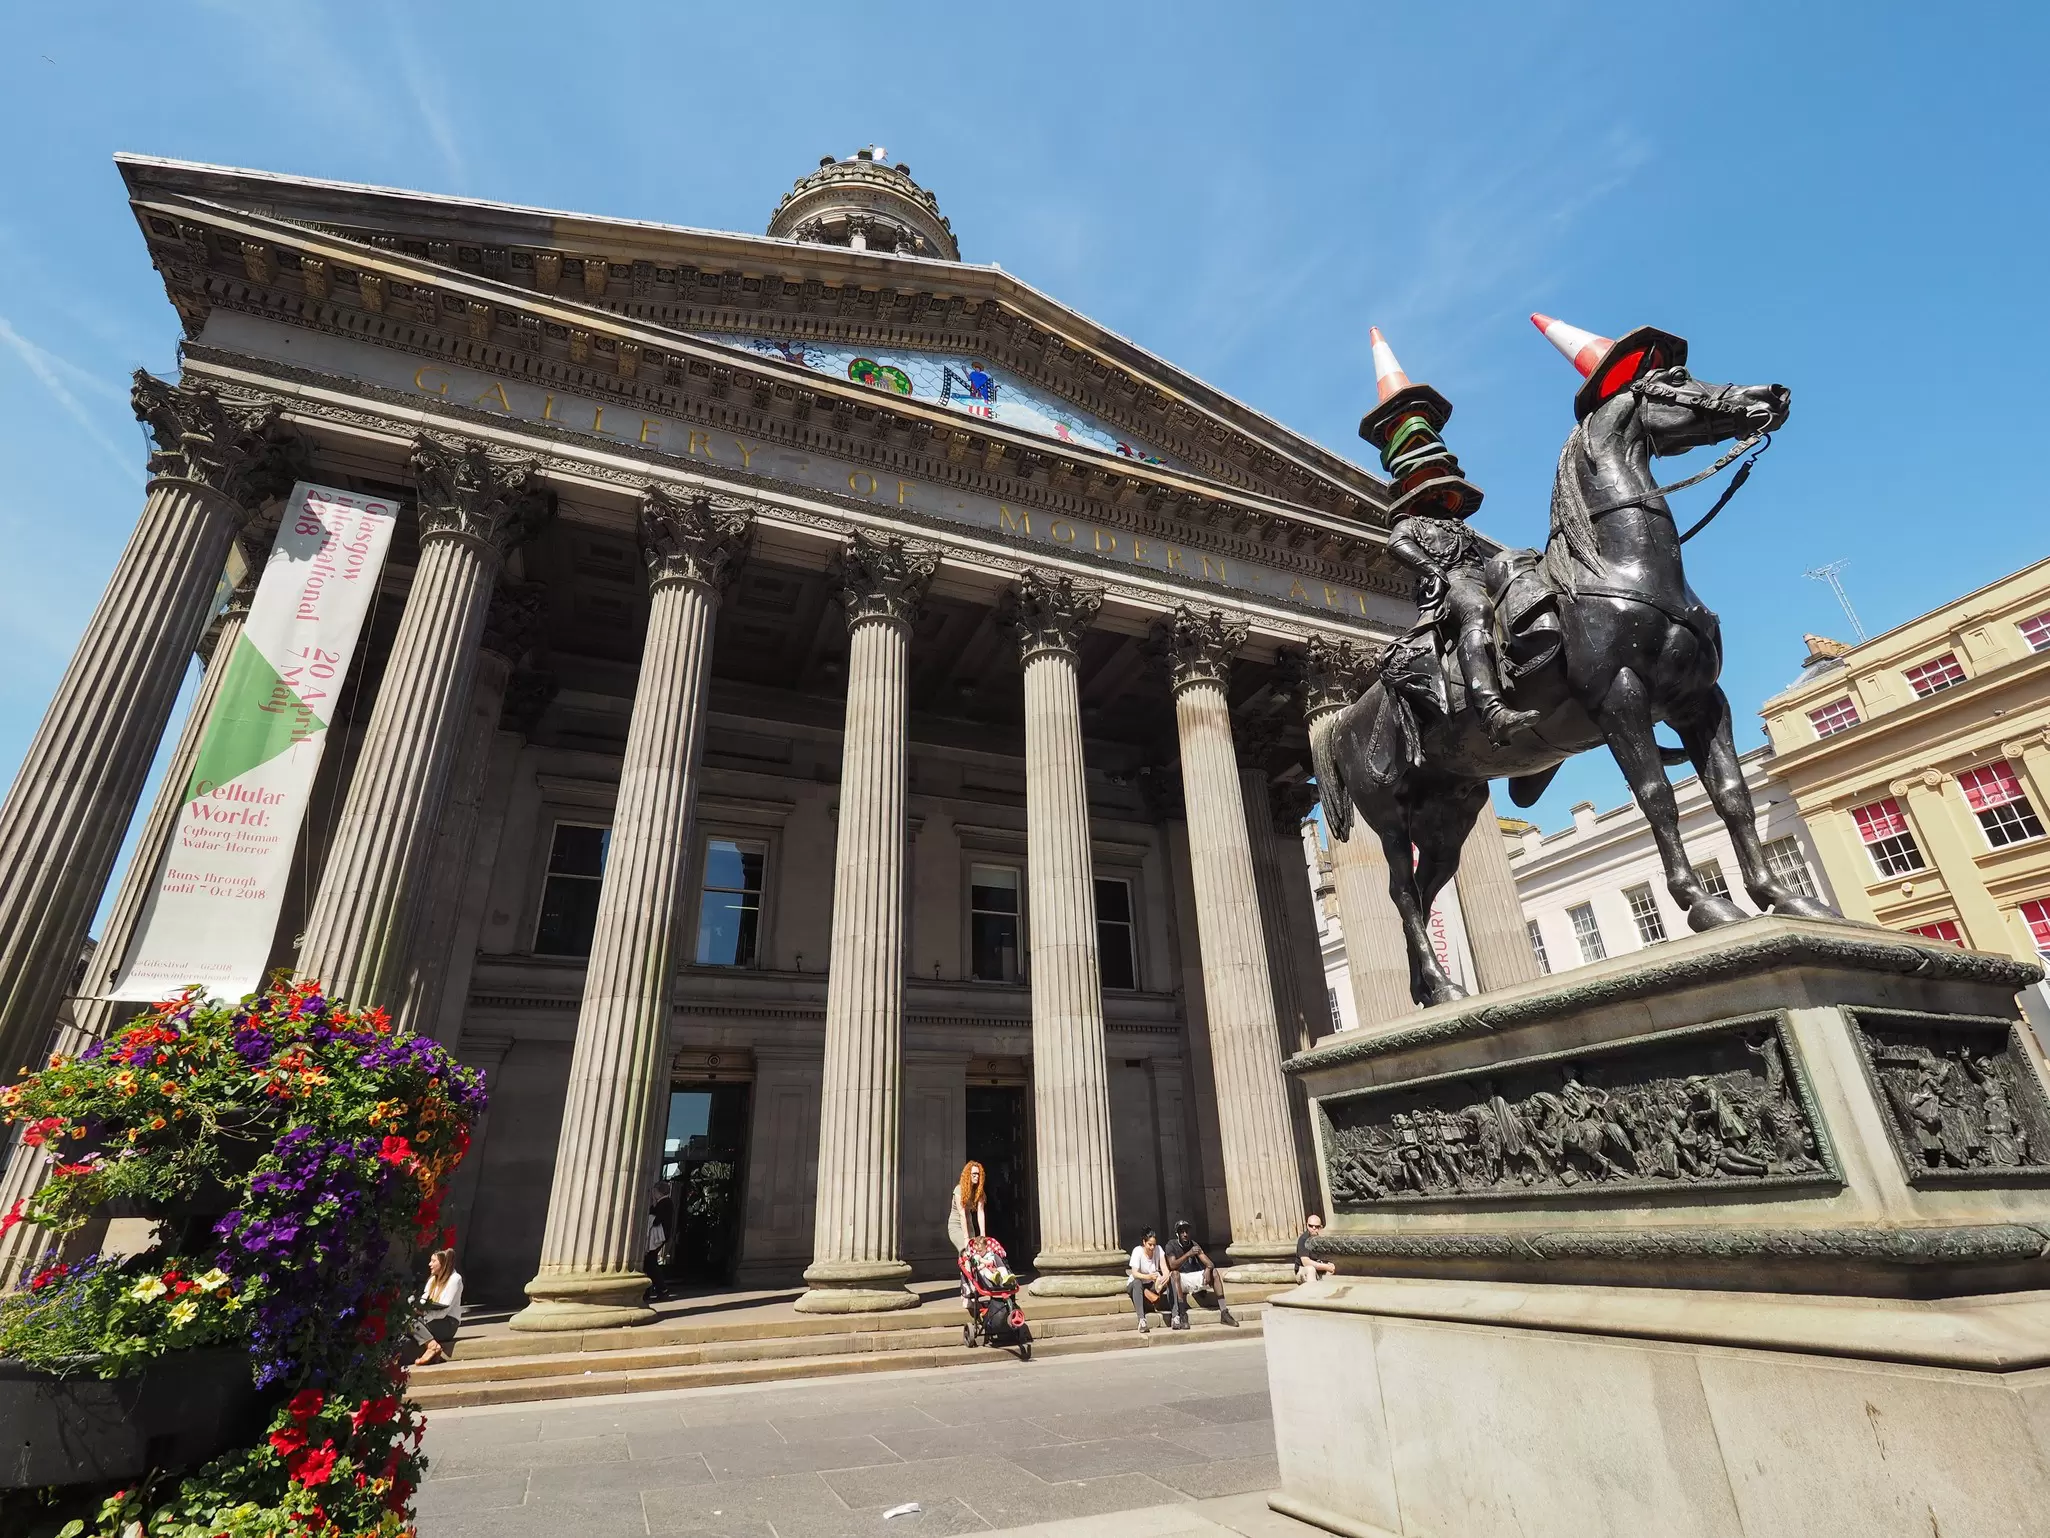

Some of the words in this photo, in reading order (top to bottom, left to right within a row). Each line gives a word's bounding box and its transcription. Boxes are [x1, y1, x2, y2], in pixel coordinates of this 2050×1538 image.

[414, 366, 760, 467] GALLERY
[848, 470, 916, 504] OF
[1000, 506, 1226, 582] MODERN
[1288, 579, 1369, 615] ART
[294, 489, 332, 536] 2018
[295, 496, 360, 621] international
[342, 502, 388, 585] Glasgow
[286, 646, 310, 659] 7
[309, 647, 341, 679] 20
[257, 664, 304, 714] May
[195, 779, 286, 805] Cellular
[190, 801, 270, 828] World:
[163, 882, 194, 894] until
[210, 886, 233, 897] Oct
[235, 888, 267, 900] 2018
[166, 868, 200, 882] Runs
[204, 872, 257, 889] through
[1429, 909, 1451, 976] BRUARY
